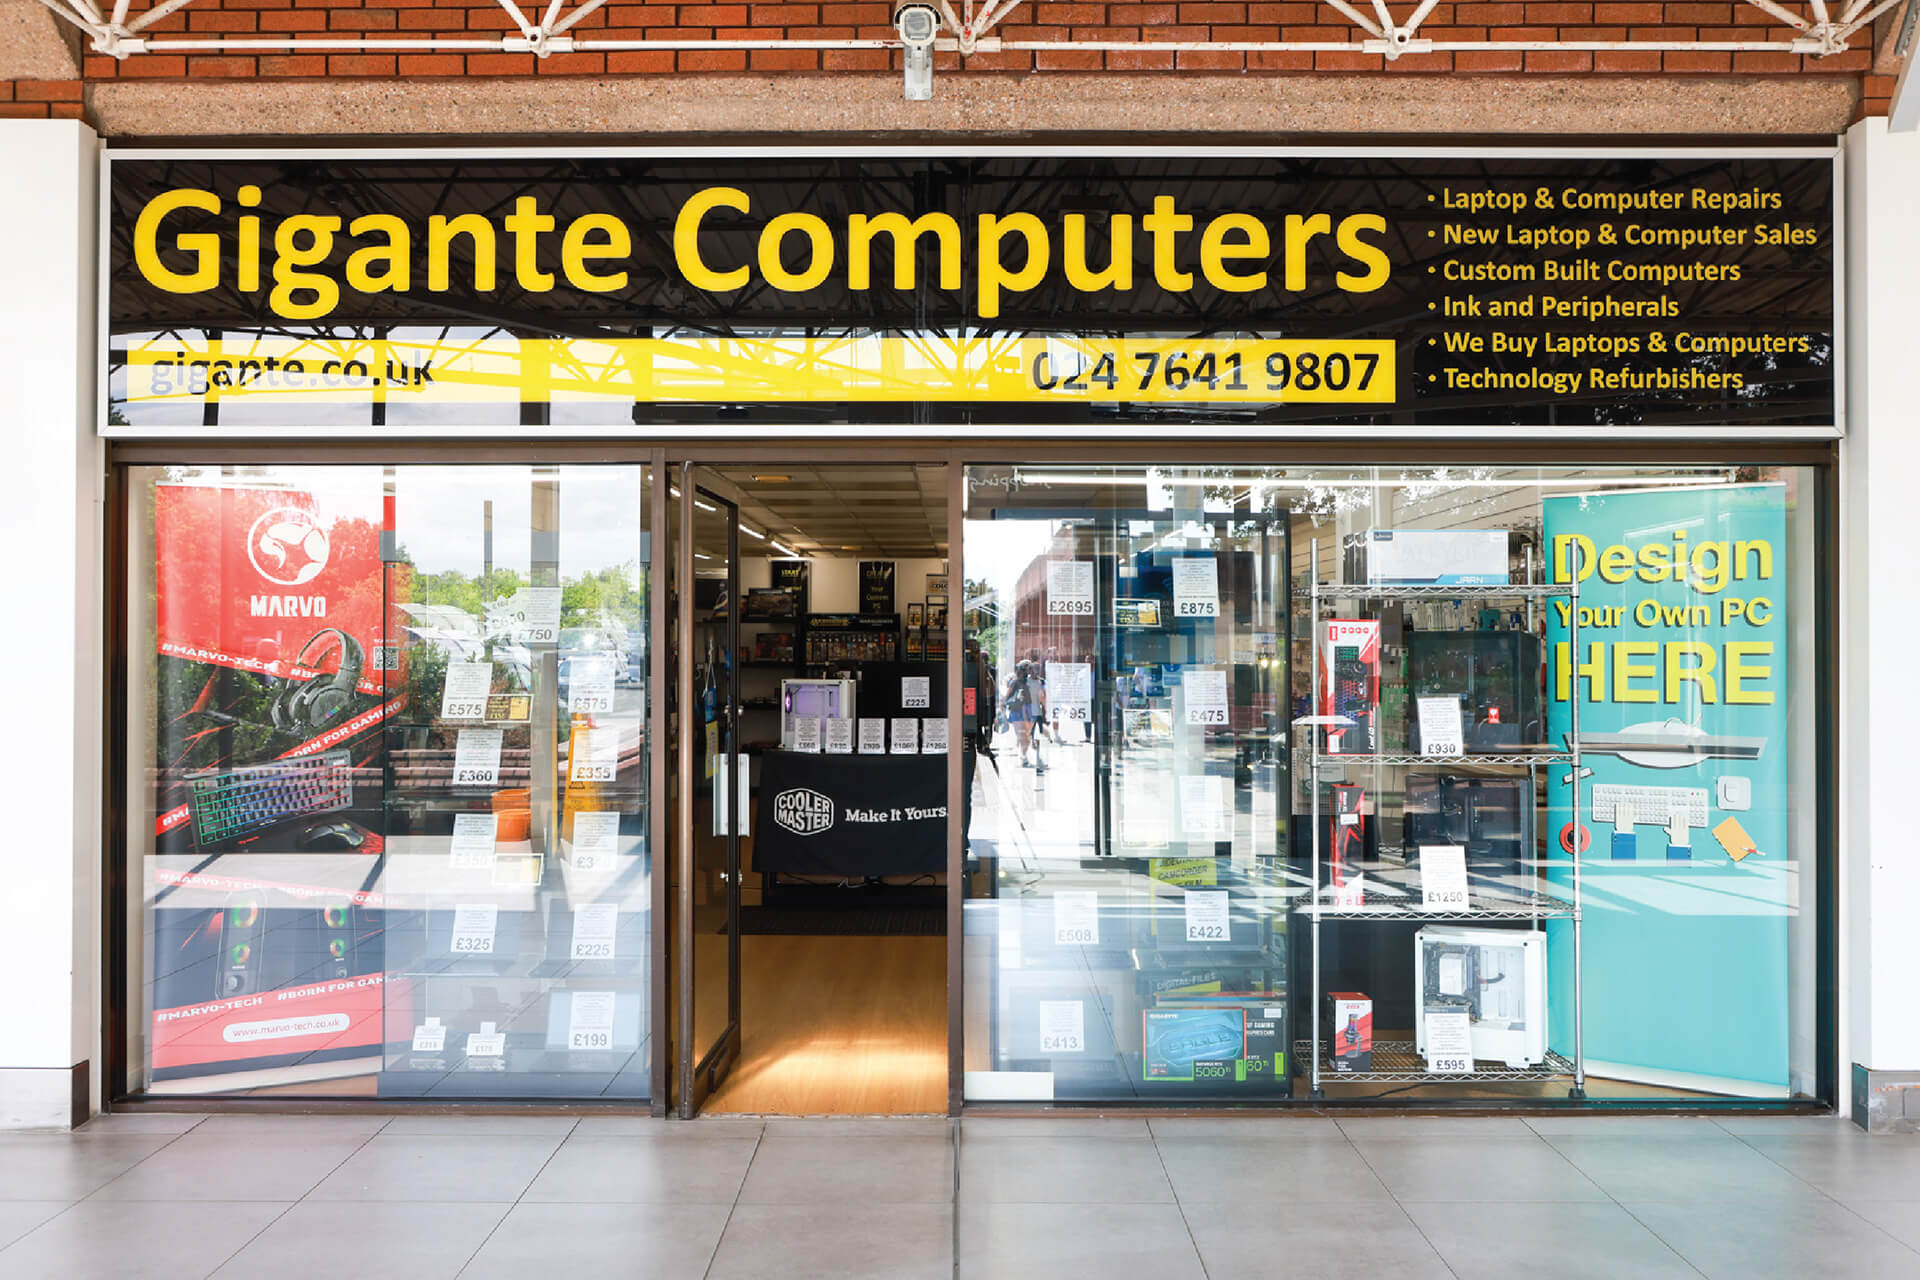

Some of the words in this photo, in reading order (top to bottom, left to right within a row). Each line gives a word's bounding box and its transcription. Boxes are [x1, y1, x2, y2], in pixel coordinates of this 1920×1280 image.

[1443, 188, 1528, 214] Laptop
[1535, 188, 1554, 208] &
[1561, 188, 1684, 214] Computer
[1691, 188, 1782, 214] Repairs
[1443, 224, 1499, 244] New
[1507, 224, 1591, 249] Laptop
[1597, 224, 1618, 244] &
[1625, 224, 1747, 249] Computer
[1754, 223, 1817, 245] Sales
[134, 185, 632, 320] Gigante
[673, 187, 1391, 318] Computers
[1443, 260, 1535, 281] Custom
[1543, 259, 1600, 281] Built
[1607, 260, 1741, 285] Computers
[1443, 295, 1482, 317] Ink
[1488, 295, 1533, 317] and
[1542, 295, 1680, 322] Peripherals
[1443, 332, 1484, 353] We
[1492, 332, 1538, 358] Buy
[1545, 332, 1640, 358] Laptops
[1647, 332, 1667, 353] &
[1675, 332, 1809, 358] Computers
[150, 351, 435, 396] gigante.co.uk
[1032, 352, 1118, 391] 024
[1137, 352, 1248, 391] 7641
[1266, 351, 1380, 391] 9807
[1443, 367, 1583, 394] Technology
[1590, 367, 1744, 389] Refurbishers
[1554, 529, 1773, 594] Design
[250, 595, 326, 617] MARVO
[1049, 601, 1092, 614] £2695
[1180, 602, 1214, 615] £875
[1554, 601, 1627, 628] Your
[1635, 599, 1711, 627] Own
[1721, 596, 1773, 627] PC
[161, 643, 280, 673] #MARVO-TECH
[1555, 641, 1775, 705] HERE
[447, 703, 482, 716] £575
[573, 697, 608, 710] £575
[1190, 710, 1225, 722] £475
[1427, 743, 1456, 754] £930
[458, 770, 493, 782] £360
[576, 767, 611, 780] £355
[778, 791, 830, 813] COOLER
[778, 809, 830, 832] MASTER
[845, 808, 888, 822] Make
[891, 808, 902, 821] It
[1428, 891, 1463, 903] £1250
[1189, 926, 1223, 939] £422
[455, 937, 491, 951] £325
[575, 943, 610, 956] £225
[157, 997, 263, 1022] #MARVO-TECH
[277, 985, 326, 1001] #BORN
[328, 981, 355, 992] FOR
[573, 1033, 608, 1046] £199
[1043, 1036, 1078, 1049] £413
[1436, 1059, 1465, 1071] £595
